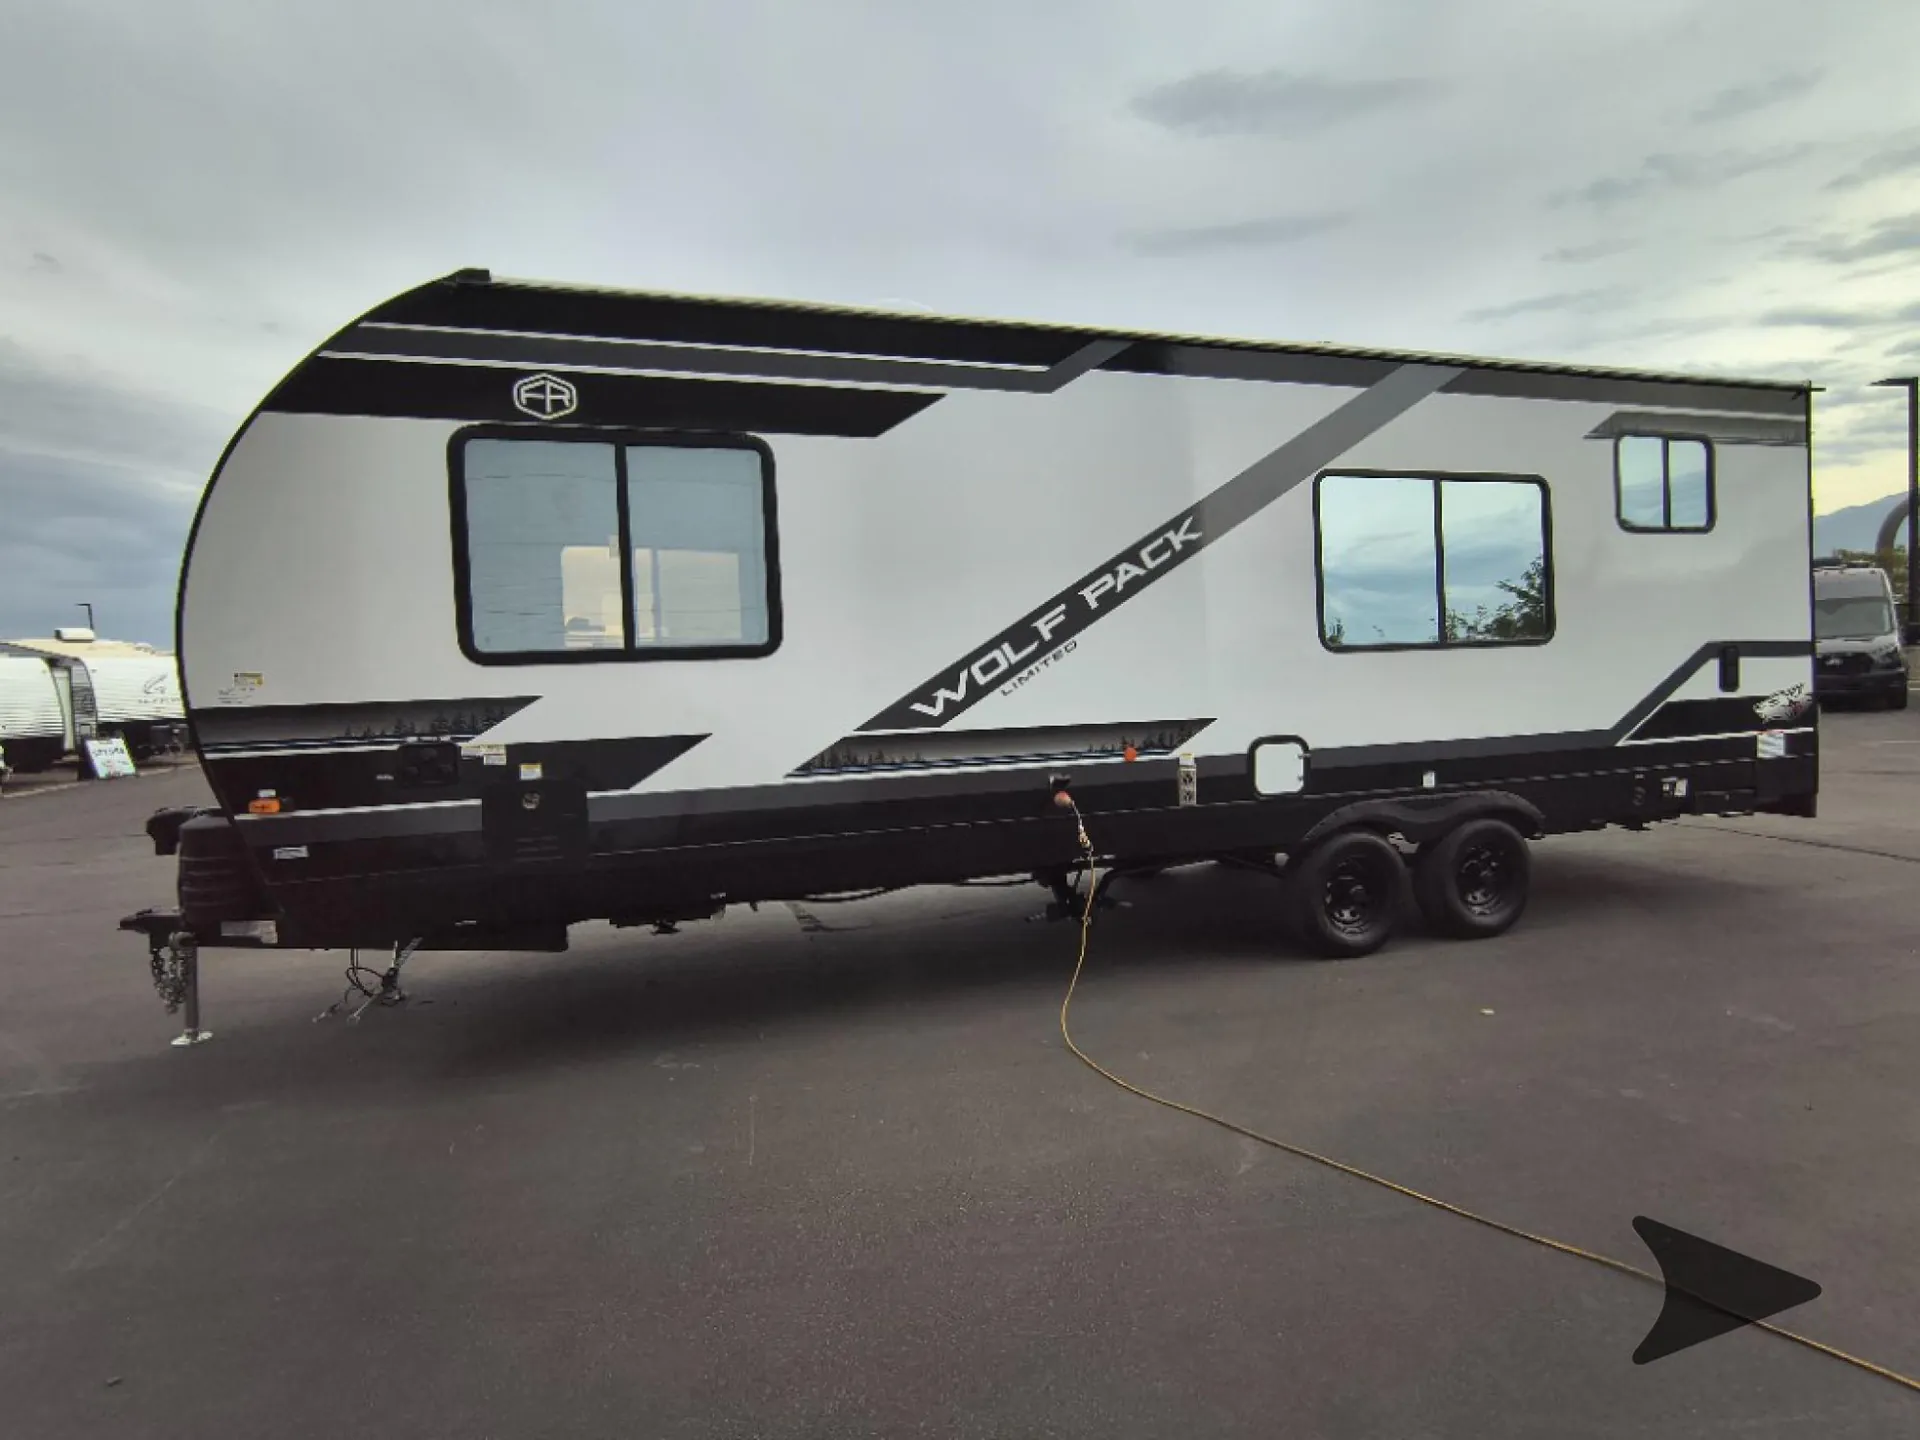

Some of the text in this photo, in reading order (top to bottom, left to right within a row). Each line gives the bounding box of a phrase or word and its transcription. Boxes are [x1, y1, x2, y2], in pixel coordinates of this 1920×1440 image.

[909, 515, 1203, 717] WOLF PACK
[1000, 640, 1077, 697] LIMITED
